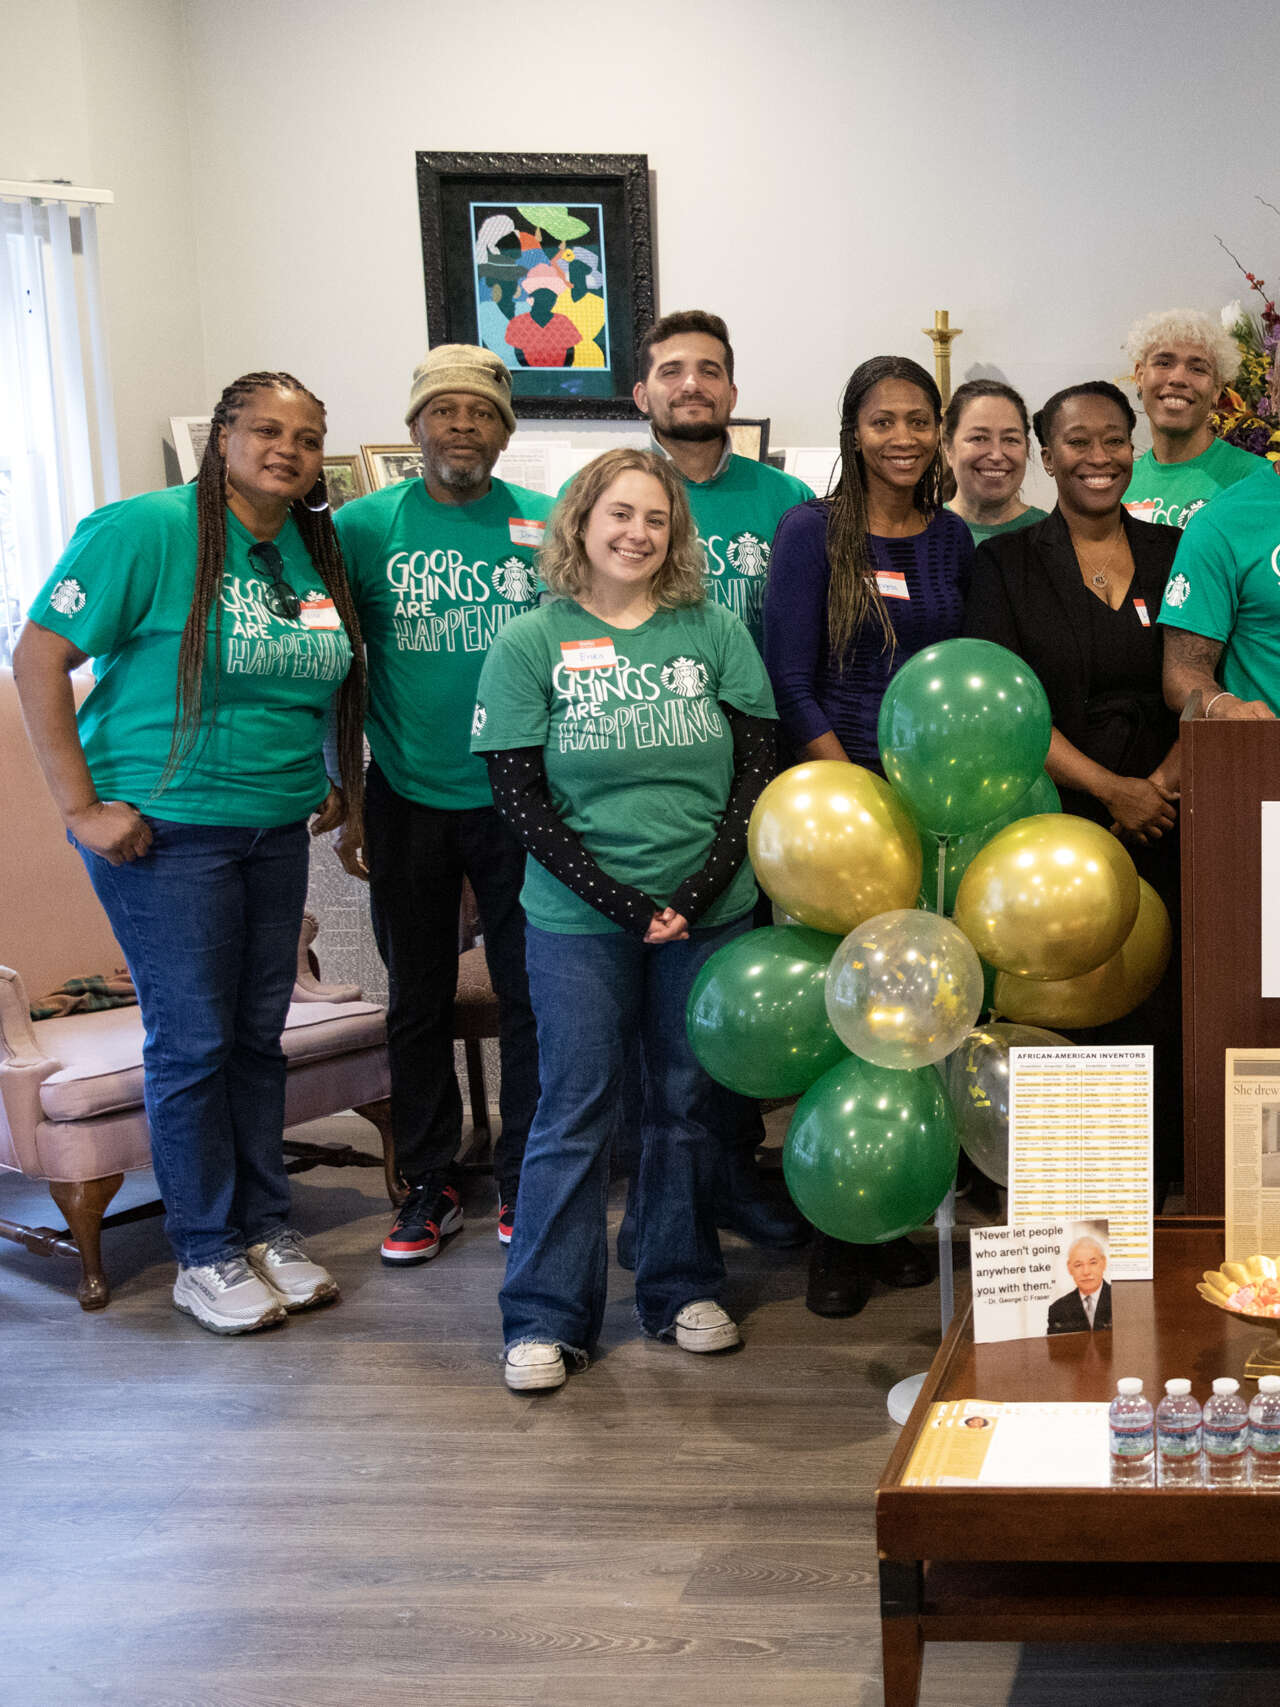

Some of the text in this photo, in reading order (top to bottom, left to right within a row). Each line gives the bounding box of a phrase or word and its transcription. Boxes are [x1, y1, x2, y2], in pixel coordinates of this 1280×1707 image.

[390, 560, 490, 602] THINGS
[394, 601, 437, 619] ARE
[232, 620, 275, 640] ARE
[558, 662, 661, 703] THINGS
[565, 702, 607, 721] ARE
[559, 697, 724, 753] HAPPENING
[1017, 1052, 1146, 1060] AFRICAN-AMERICAN INVENTORS
[1233, 1084, 1252, 1096] She
[1254, 1084, 1279, 1096] drew
[1013, 1229, 1026, 1238] let
[1028, 1226, 1064, 1239] people
[976, 1245, 1061, 1259] who aren't going
[976, 1263, 1052, 1279] anywhere take
[977, 1288, 996, 1298] you
[998, 1283, 1020, 1294] with
[998, 1296, 1022, 1304] George
